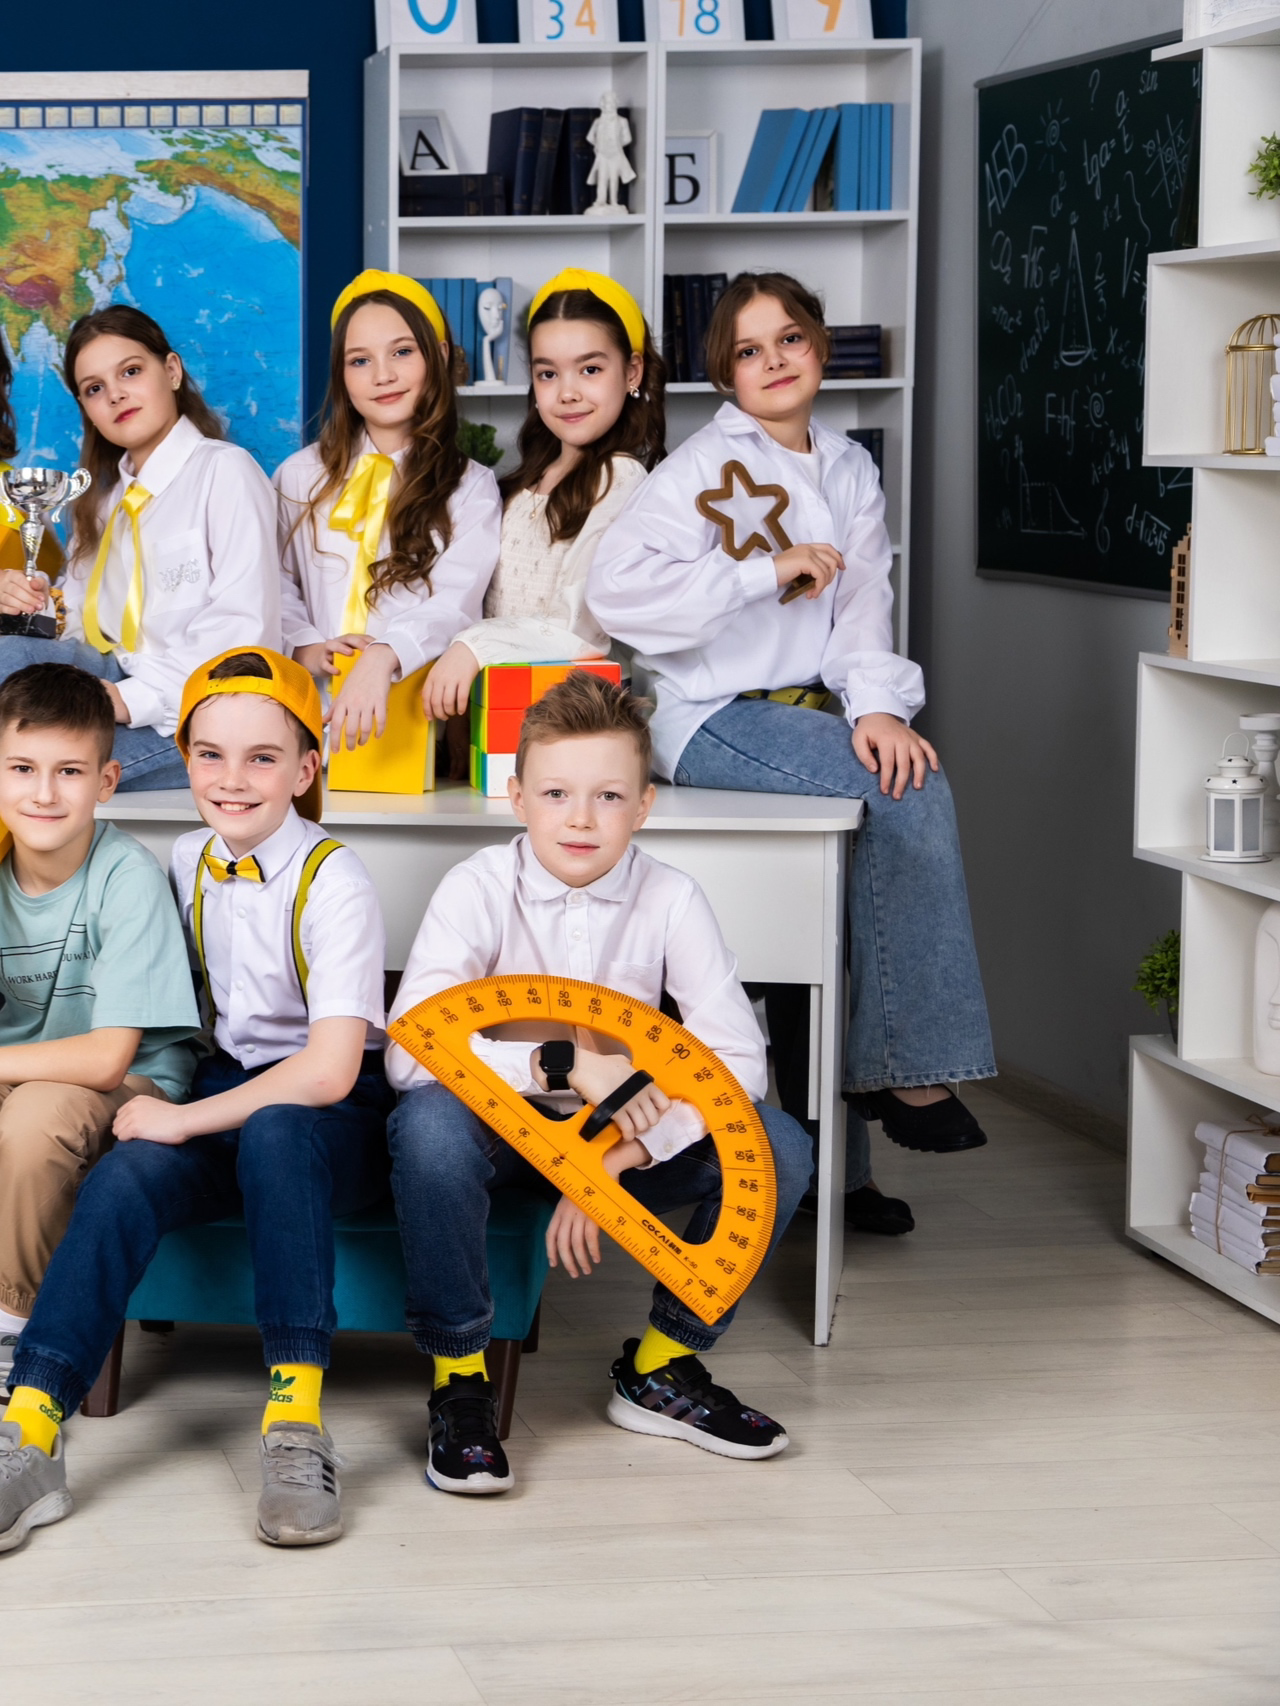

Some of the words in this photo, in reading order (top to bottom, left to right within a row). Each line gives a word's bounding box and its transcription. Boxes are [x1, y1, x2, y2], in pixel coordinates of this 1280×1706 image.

[410, 129, 450, 170] А
[664, 152, 701, 206] Б
[7, 975, 36, 985] WORK
[671, 1043, 691, 1060] 90
